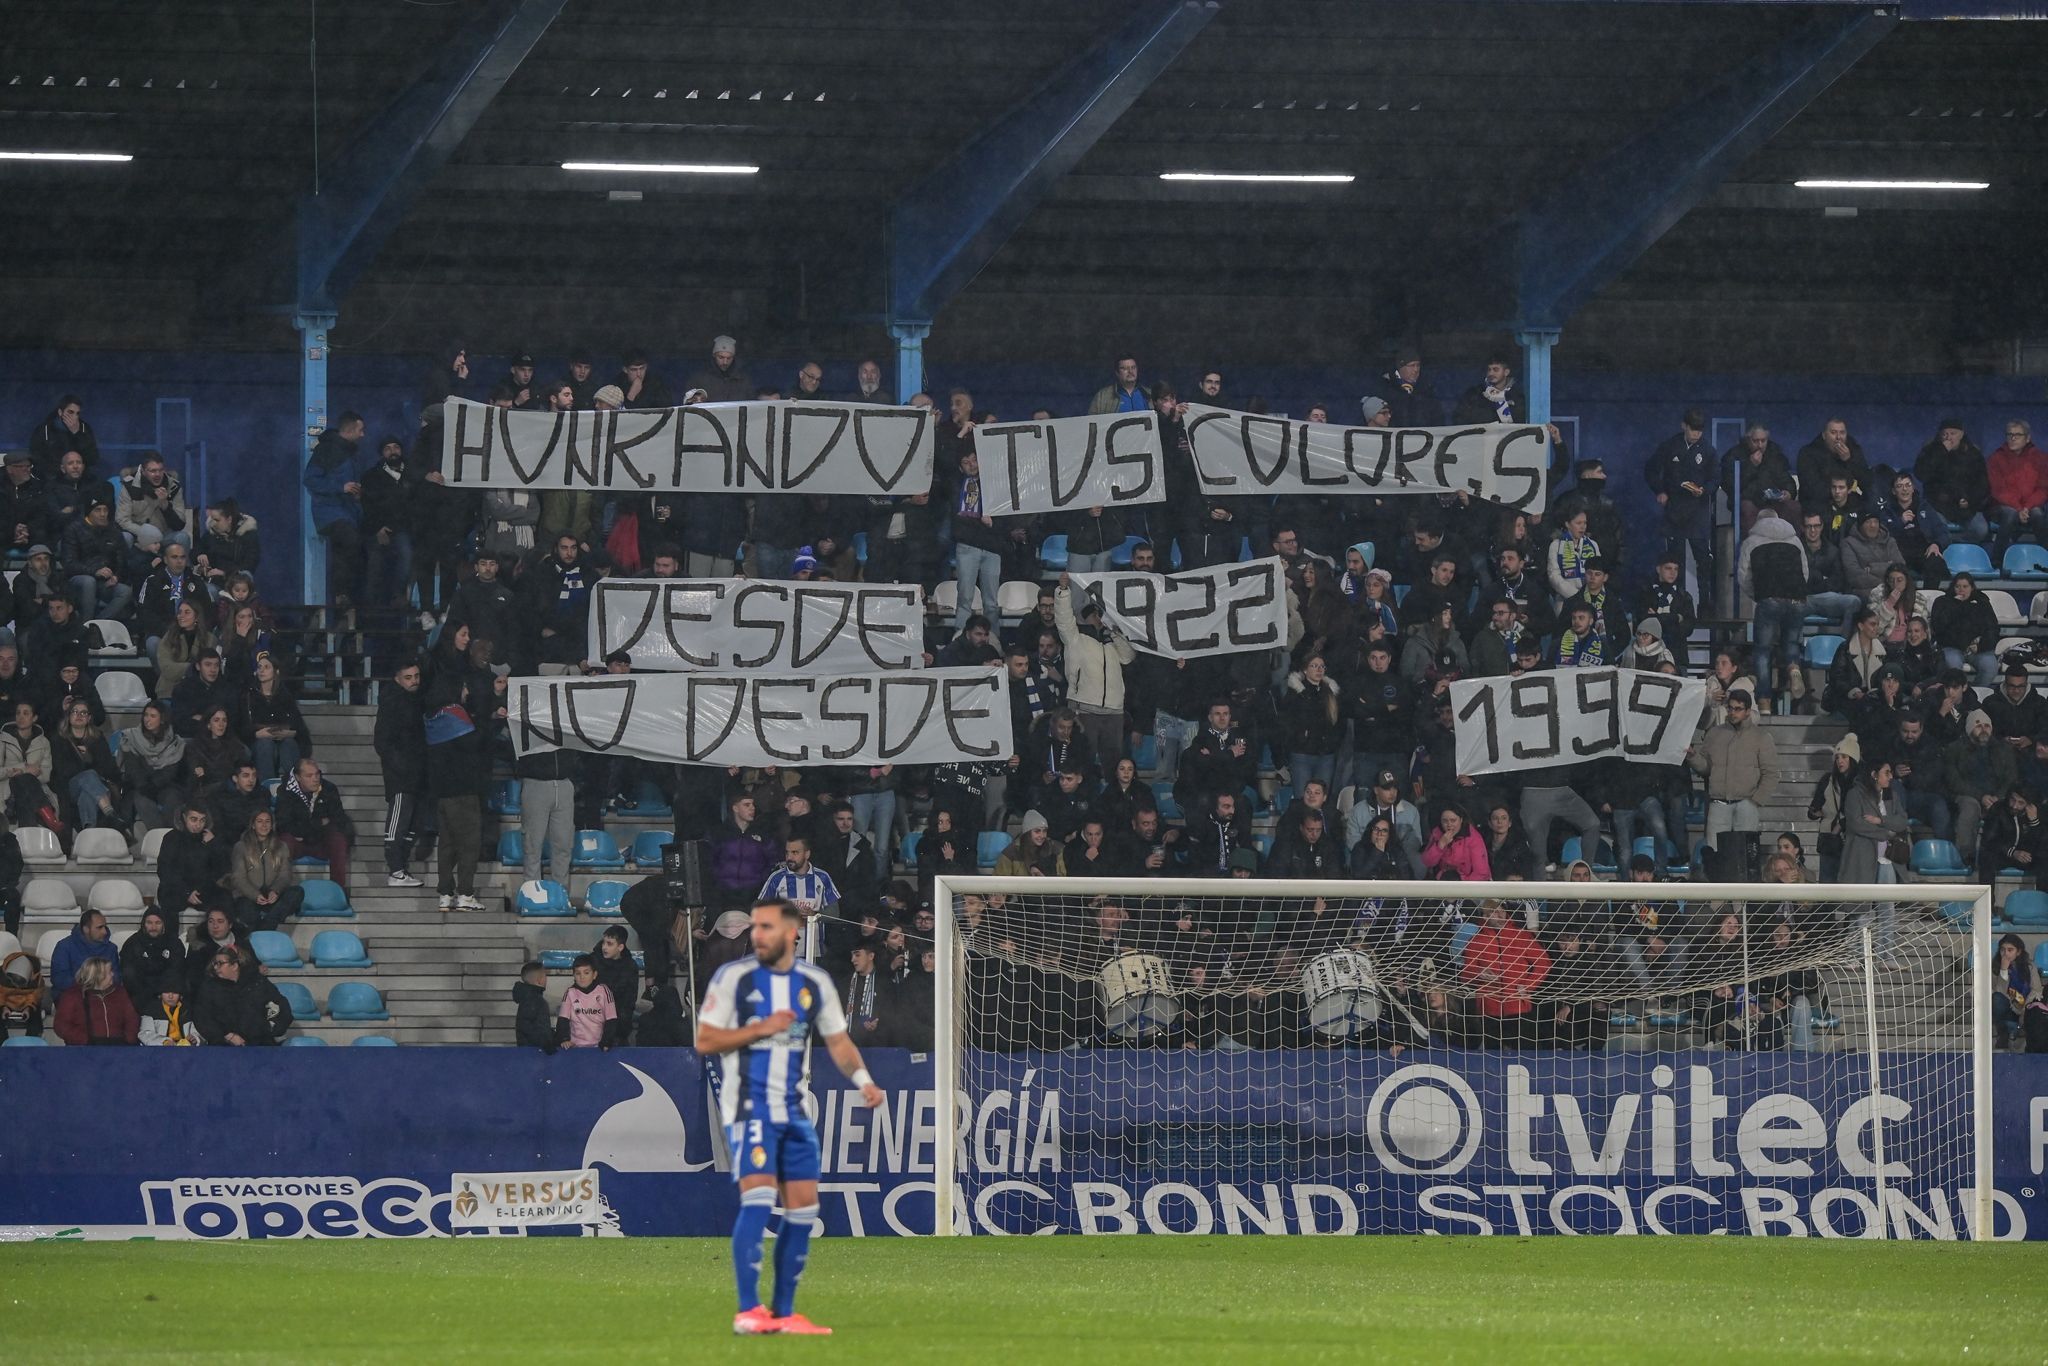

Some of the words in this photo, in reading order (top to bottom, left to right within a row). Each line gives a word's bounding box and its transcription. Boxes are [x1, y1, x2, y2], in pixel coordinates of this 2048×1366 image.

[982, 416, 1153, 511] TUS
[599, 583, 915, 670] DESDE
[520, 680, 637, 752] NO
[687, 676, 1000, 761] DESDE
[1459, 672, 1682, 764] 1999
[748, 1119, 763, 1143] 3
[1507, 1064, 1913, 1178] tvitec
[180, 1183, 355, 1197] ELEVACIONES
[482, 1179, 593, 1204] VERSUS
[496, 1204, 584, 1218] E-LEARNING
